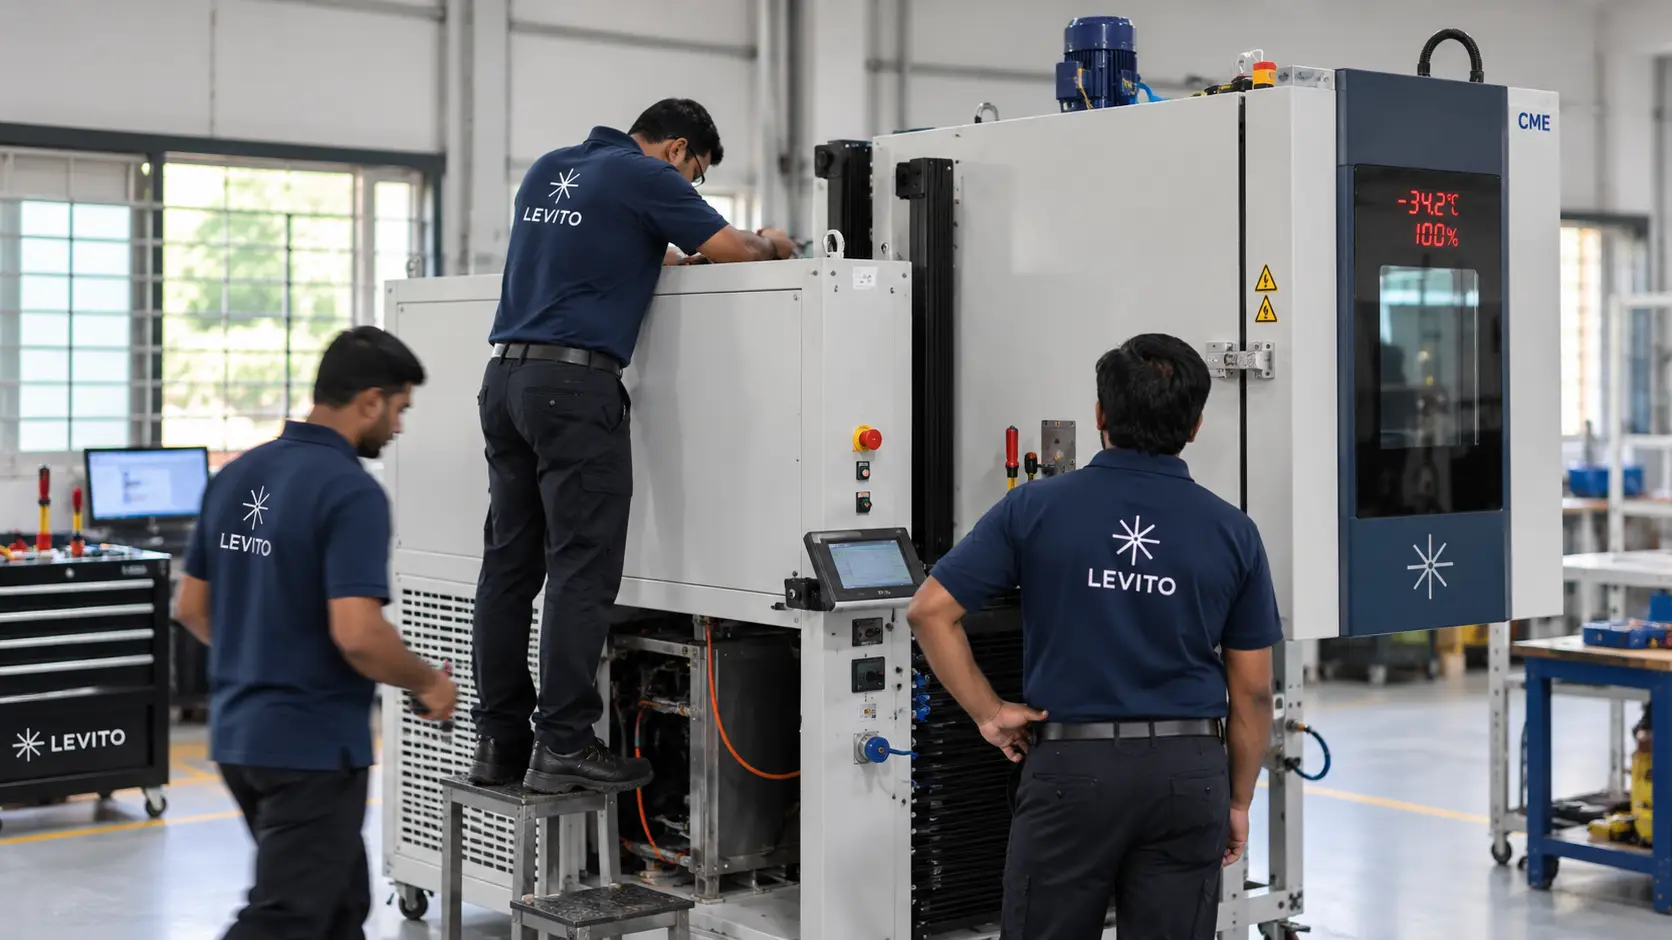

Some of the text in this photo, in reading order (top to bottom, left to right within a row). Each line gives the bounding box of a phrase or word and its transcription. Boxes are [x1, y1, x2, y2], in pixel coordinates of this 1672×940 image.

[1518, 112, 1551, 131] CME
[523, 207, 583, 227] LEVITO
[1415, 222, 1459, 247] 100%
[219, 532, 272, 557] LEVITO
[1087, 567, 1177, 596] LEVITO
[50, 728, 126, 753] LEVITO
